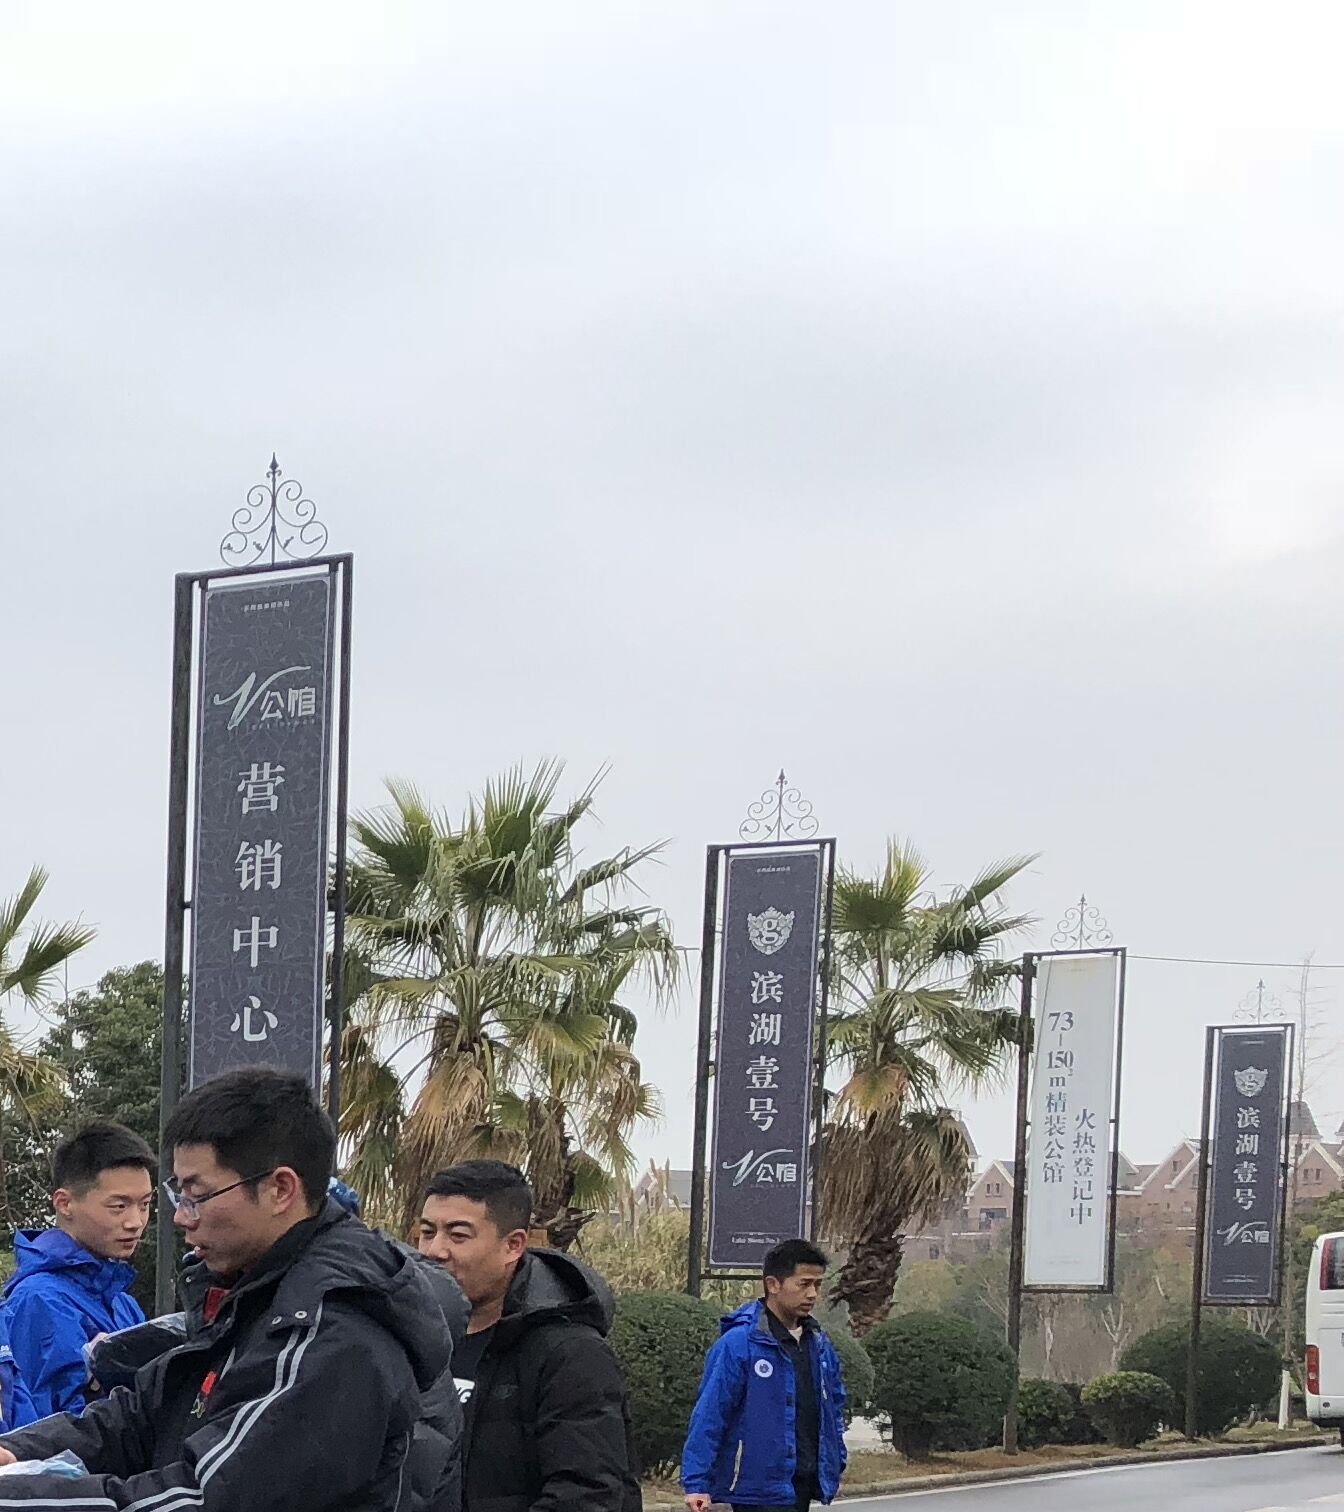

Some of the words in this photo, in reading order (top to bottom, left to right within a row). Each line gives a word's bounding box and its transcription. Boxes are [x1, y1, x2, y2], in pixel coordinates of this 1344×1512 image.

[230, 761, 286, 1043] 营销中心
[744, 970, 784, 1132] 滨湖壹号
[1070, 1108, 1097, 1225] 火热登记中
[1233, 1106, 1261, 1211] 滨湖壹号
